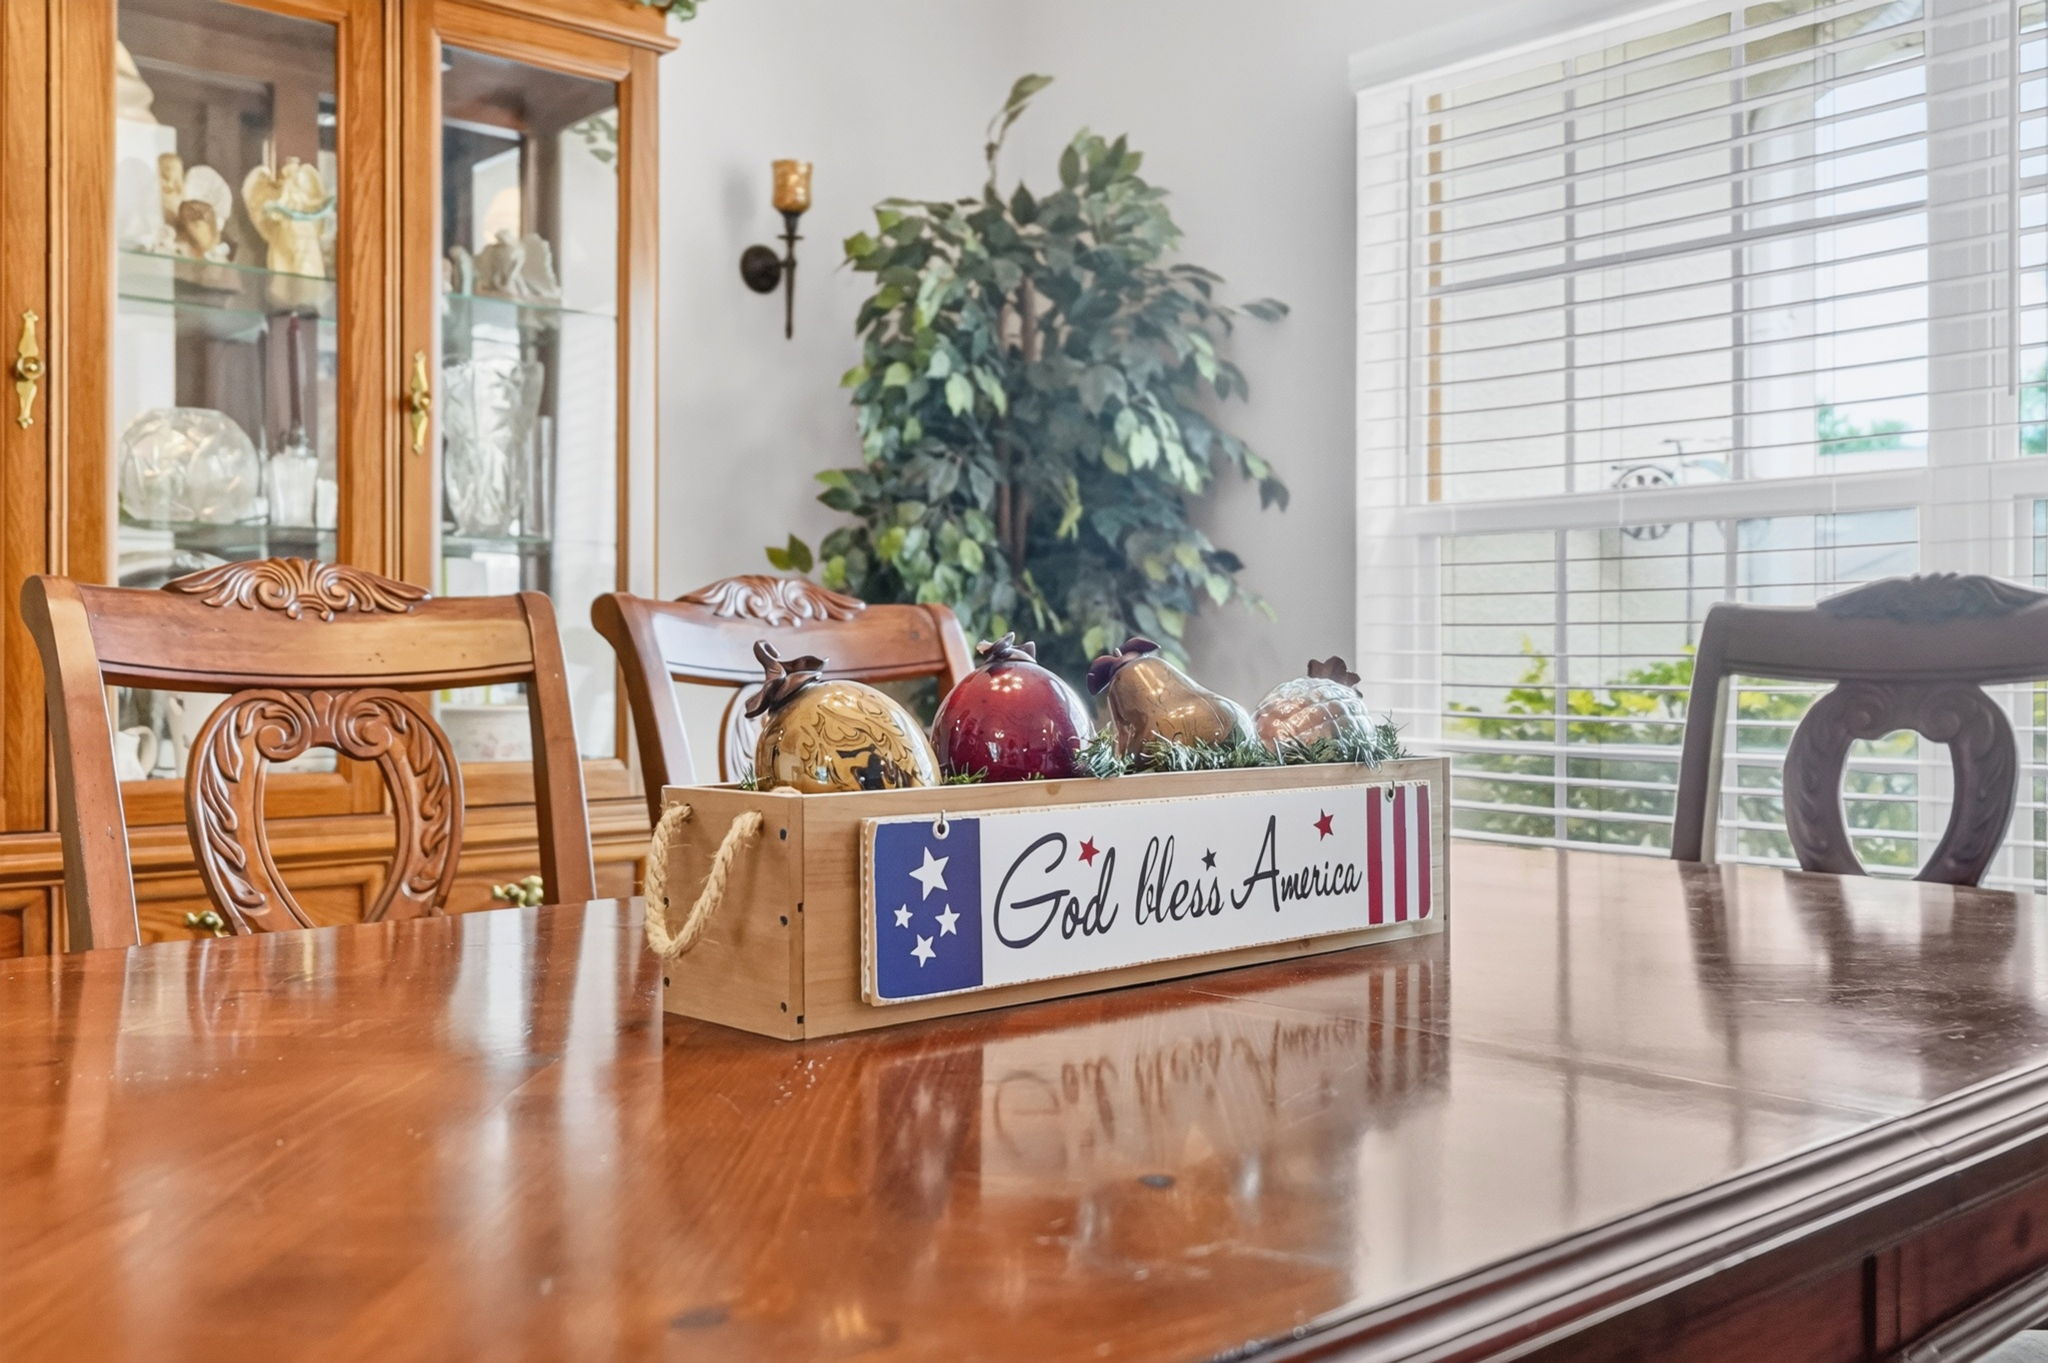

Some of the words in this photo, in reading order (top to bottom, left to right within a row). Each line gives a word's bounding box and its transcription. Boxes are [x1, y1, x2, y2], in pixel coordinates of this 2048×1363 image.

[993, 831, 1119, 949] God
[1135, 835, 1225, 925] bless
[1230, 814, 1363, 912] America
